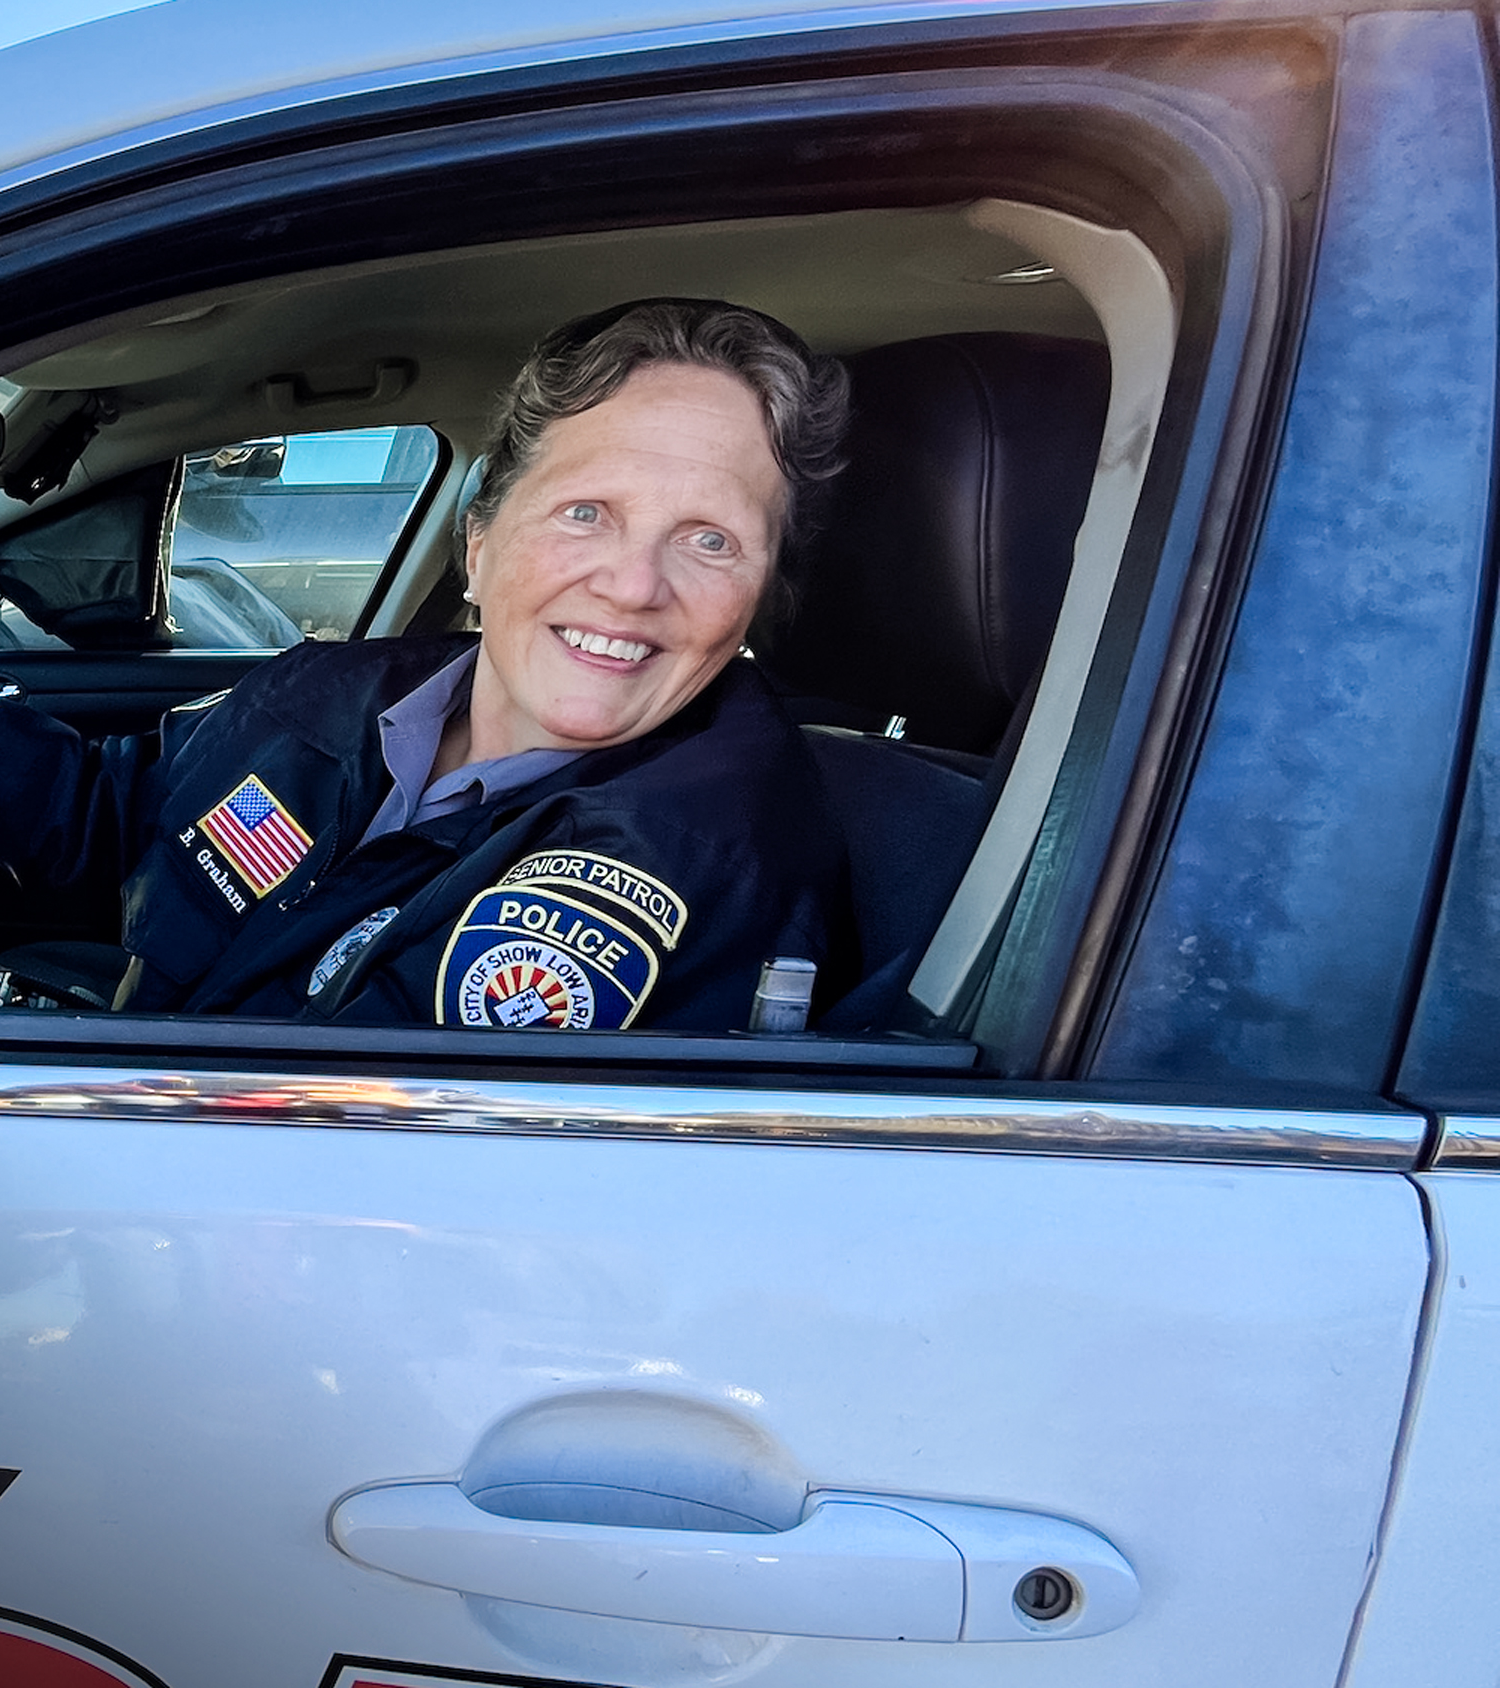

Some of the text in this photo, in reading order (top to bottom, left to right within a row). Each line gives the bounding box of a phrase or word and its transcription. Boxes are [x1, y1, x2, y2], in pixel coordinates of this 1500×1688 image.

[179, 826, 247, 914] B. Graham
[504, 857, 680, 933] SENIOR PATROL
[498, 900, 630, 971] POLICE
[464, 946, 589, 1026] CITY OF SHOW LOW ARI
